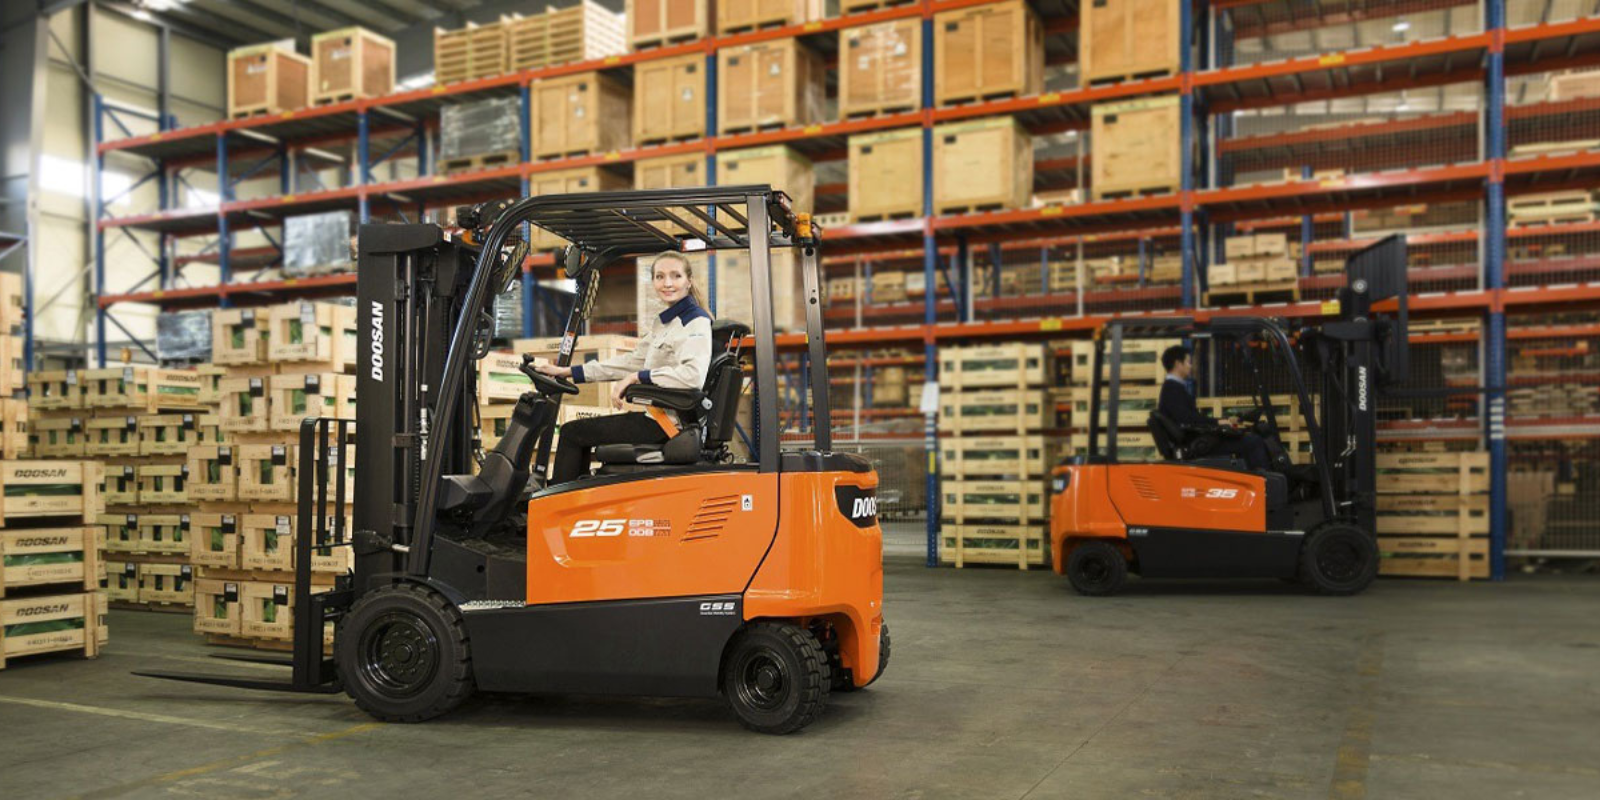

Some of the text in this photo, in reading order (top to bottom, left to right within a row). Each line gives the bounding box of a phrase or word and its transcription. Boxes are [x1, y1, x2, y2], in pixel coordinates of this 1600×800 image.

[371, 300, 384, 382] DOOSAN
[1358, 365, 1367, 411] DOOSAN
[14, 469, 67, 478] DOOSAN
[1205, 488, 1239, 498] 35
[569, 519, 627, 537] 25
[15, 537, 68, 547] DOOSAN
[16, 604, 69, 616] DOOSAN
[700, 602, 735, 610] GSS
